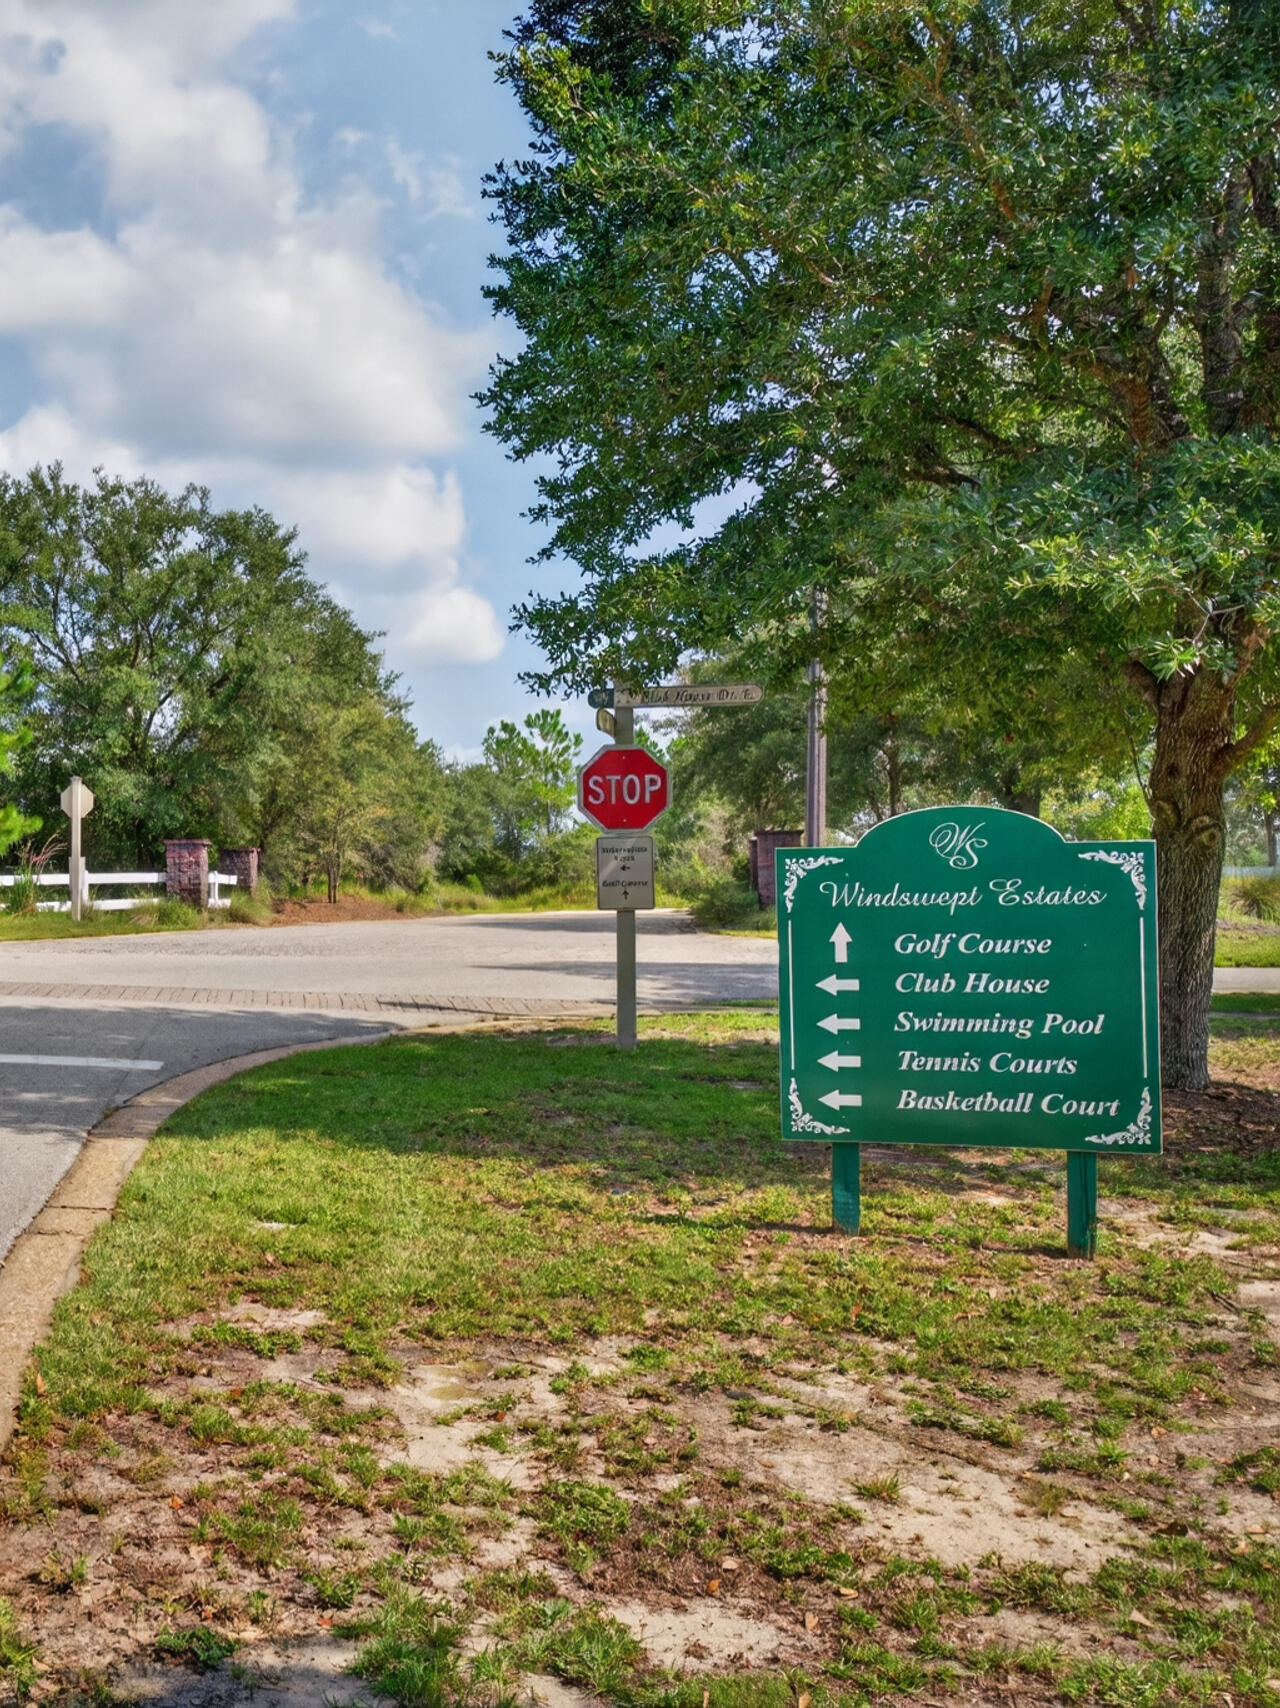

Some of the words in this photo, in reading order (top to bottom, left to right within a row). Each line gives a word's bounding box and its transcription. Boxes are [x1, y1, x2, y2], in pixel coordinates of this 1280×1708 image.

[588, 773, 662, 805] STOP
[819, 881, 983, 916] Windswept
[989, 878, 1108, 906] Estates
[894, 932, 957, 959] Golf
[958, 932, 1052, 954] Course
[895, 972, 956, 993] Club
[963, 972, 1050, 994] House
[893, 1011, 1034, 1040] Swimming
[1041, 1013, 1105, 1035] Pool
[898, 1050, 981, 1073] Tennis
[989, 1052, 1078, 1075] Courts
[896, 1089, 1034, 1114] Basketball
[1040, 1093, 1121, 1117] Court
